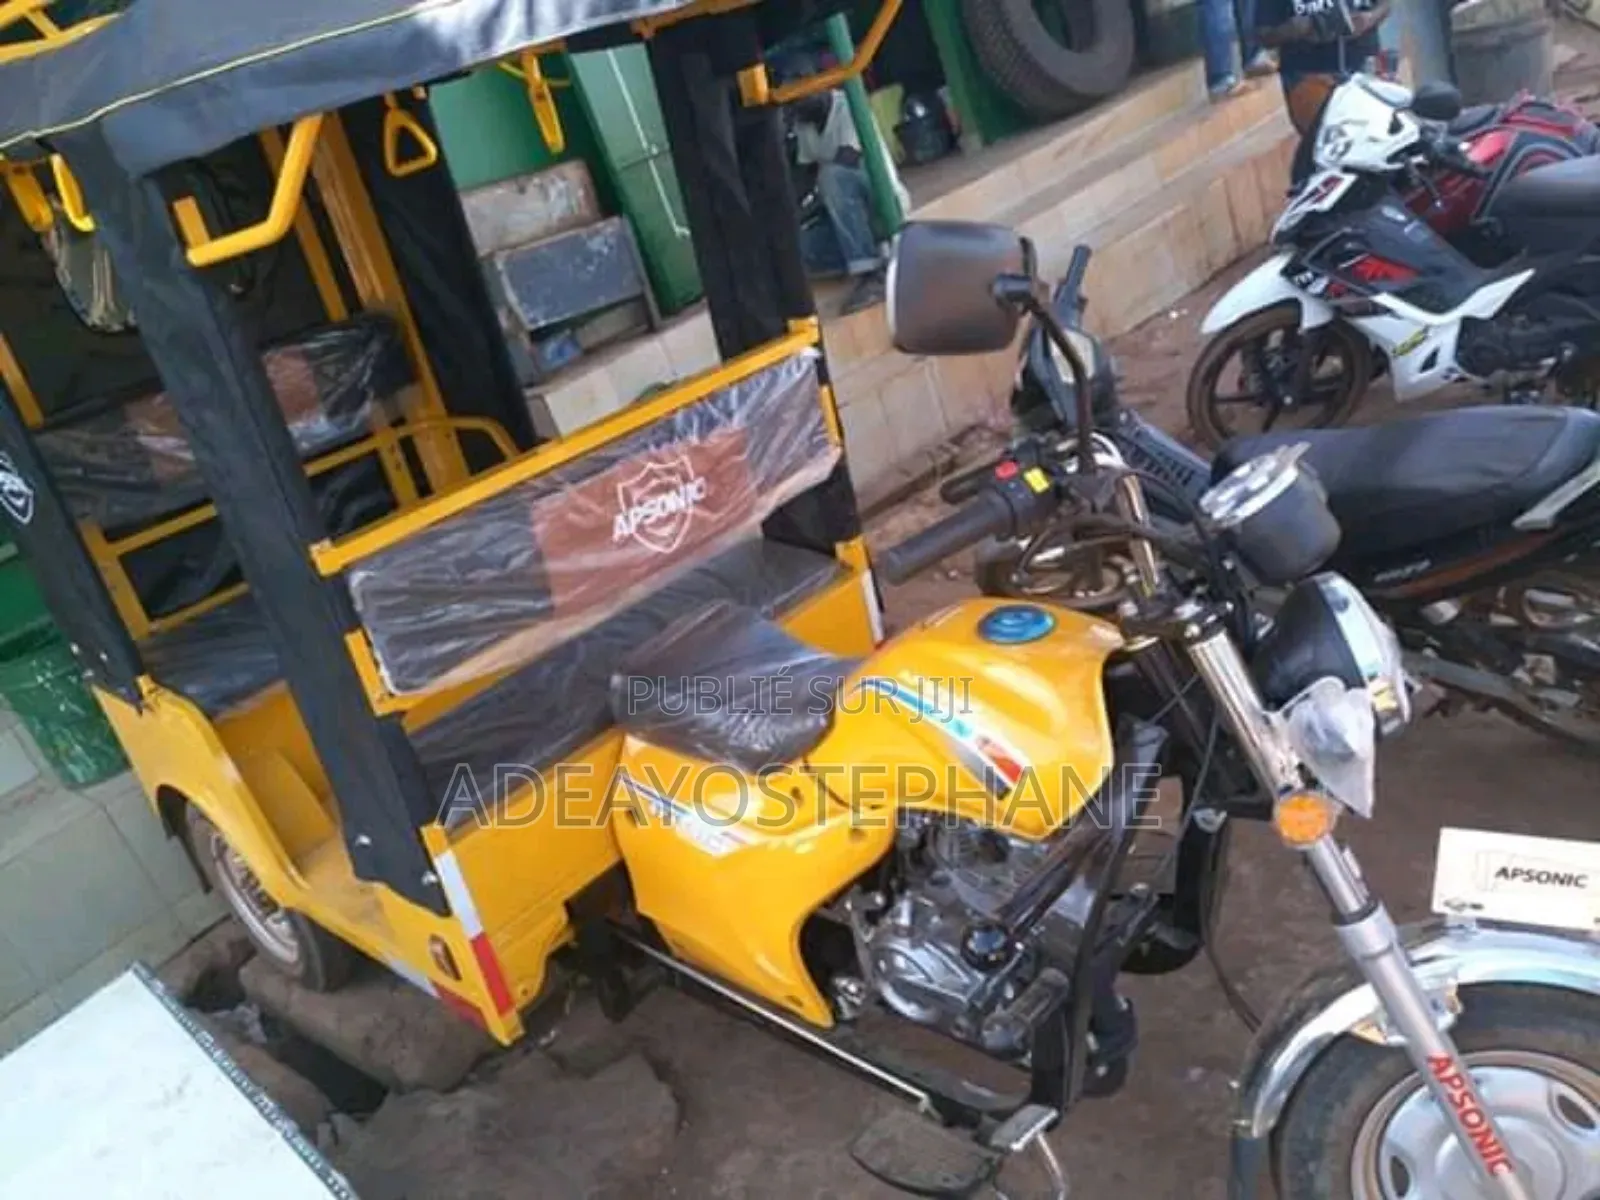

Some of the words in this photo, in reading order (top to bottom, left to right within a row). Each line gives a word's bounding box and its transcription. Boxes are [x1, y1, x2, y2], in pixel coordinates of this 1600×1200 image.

[612, 476, 707, 543] APSONIC
[1494, 865, 1589, 889] APSONIC
[1426, 1055, 1517, 1178] APSONIC
